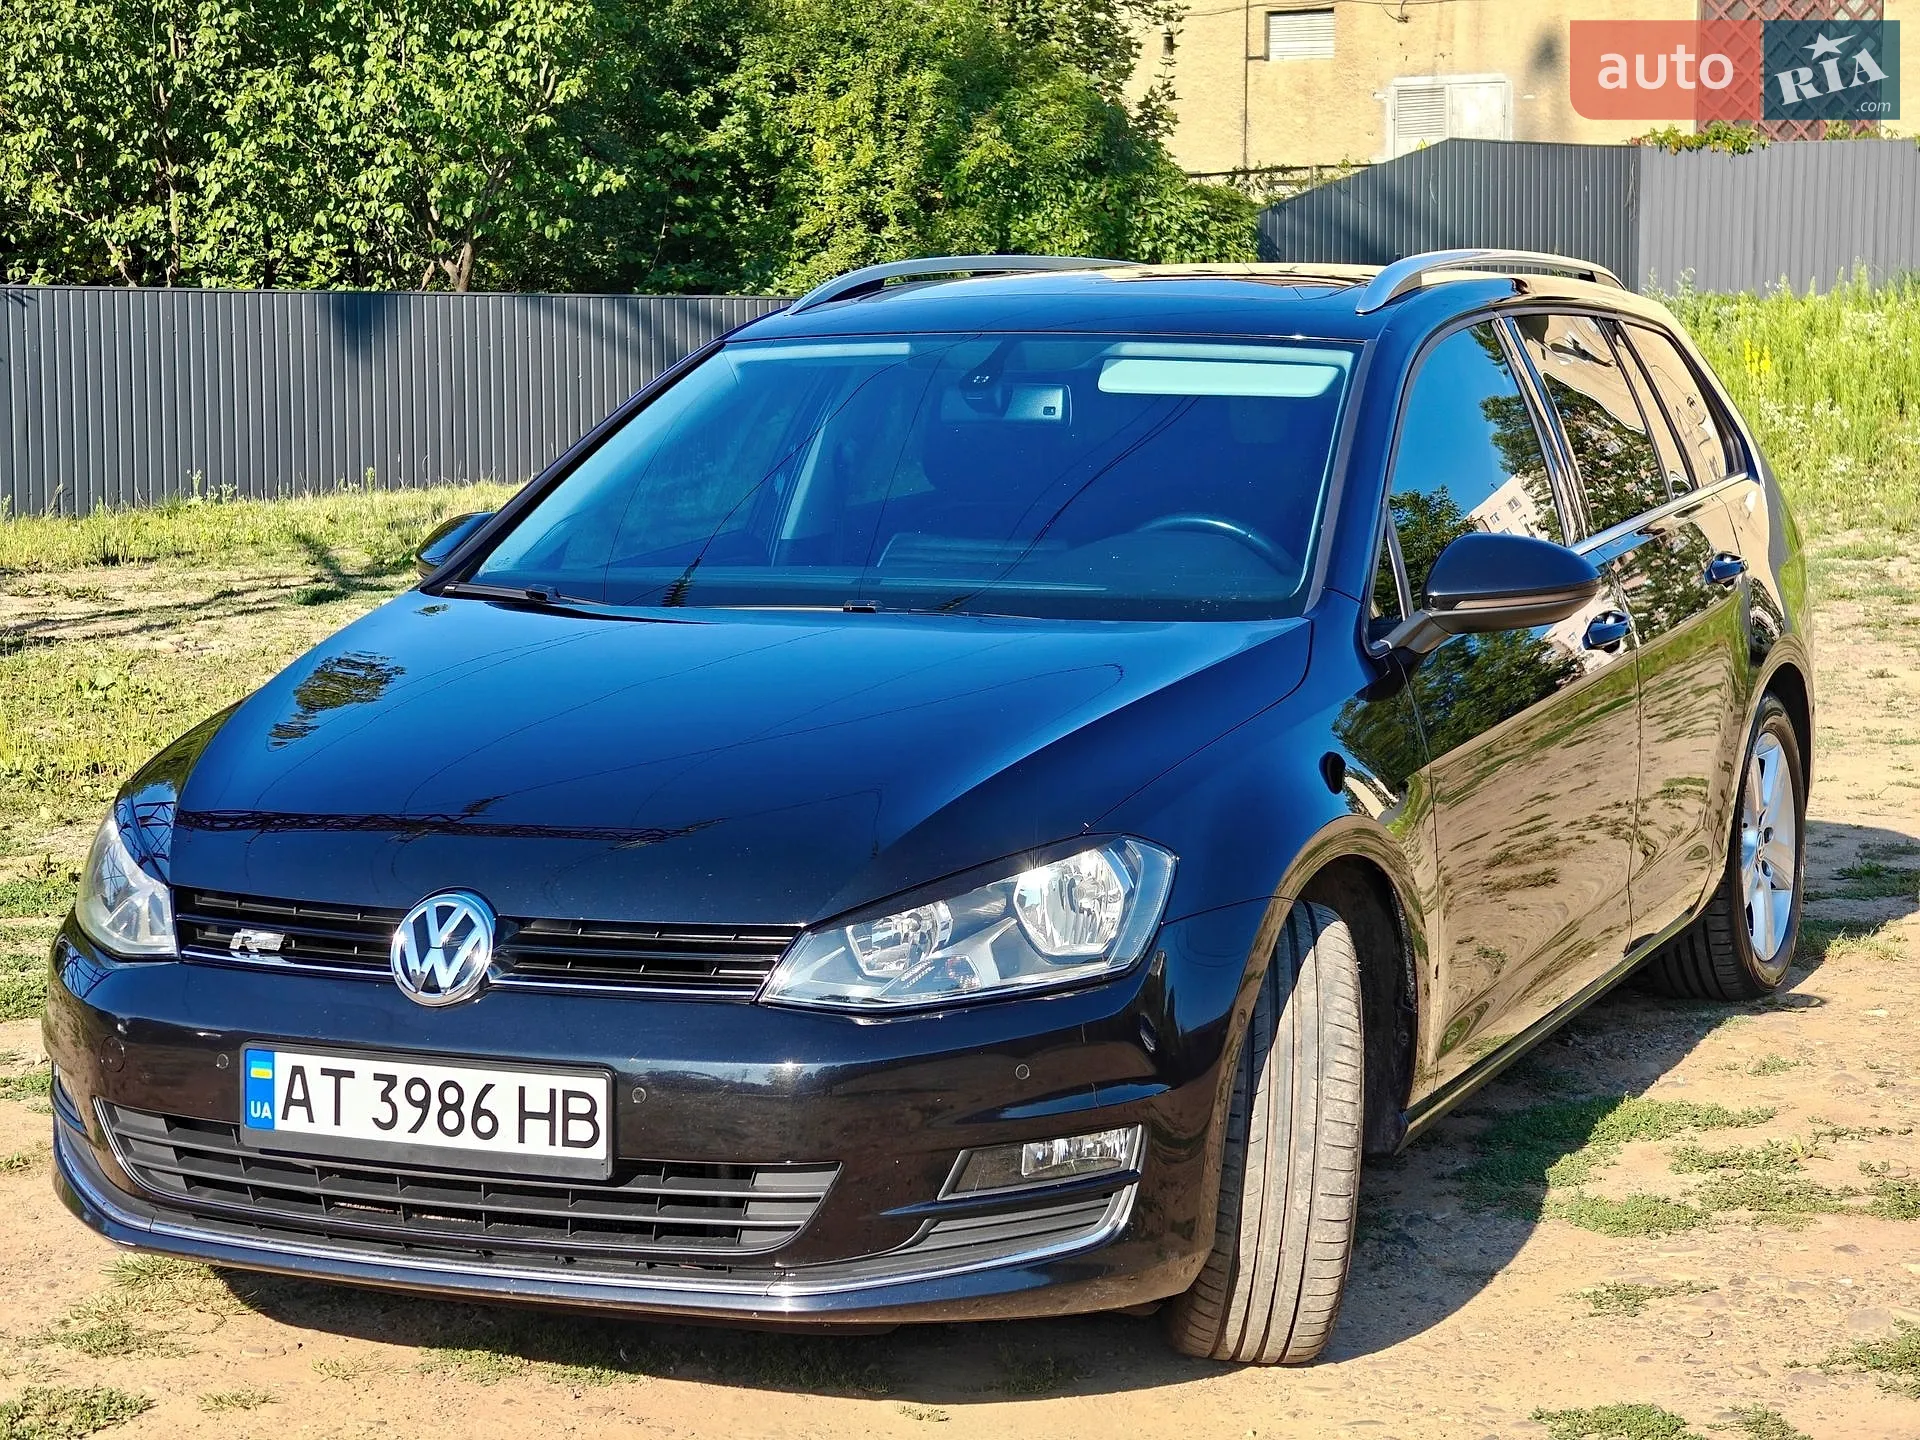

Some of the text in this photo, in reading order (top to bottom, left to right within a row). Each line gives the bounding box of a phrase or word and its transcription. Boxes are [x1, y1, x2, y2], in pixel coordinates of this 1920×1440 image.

[250, 1100, 272, 1120] UA
[281, 1065, 601, 1149] AT 3986 HB
